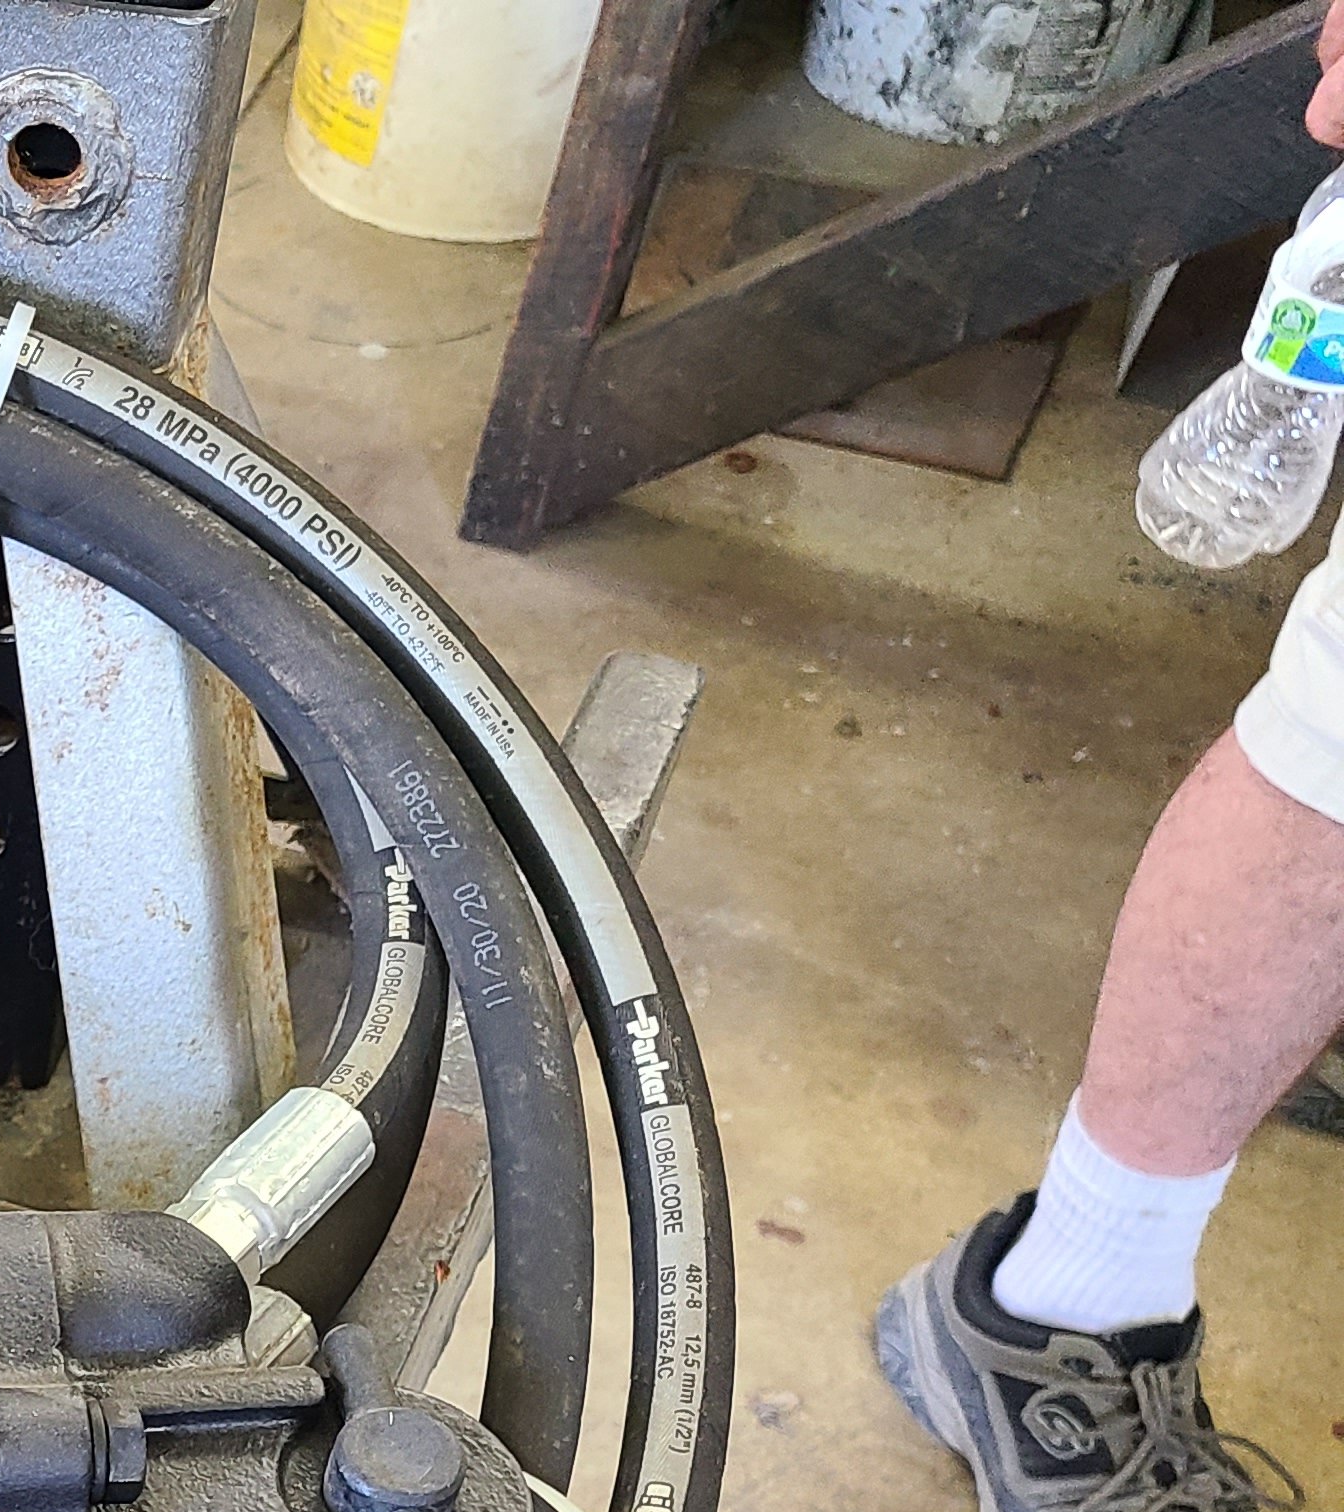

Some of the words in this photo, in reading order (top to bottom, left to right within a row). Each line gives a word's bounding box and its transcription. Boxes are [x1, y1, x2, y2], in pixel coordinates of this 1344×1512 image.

[113, 384, 157, 422] 28
[156, 408, 222, 464] MPa
[223, 451, 304, 521] (4000
[299, 512, 364, 573] PSI)
[391, 614, 411, 637] TO
[409, 600, 430, 623] TO
[462, 691, 490, 727] MADE
[486, 719, 500, 738] IN
[494, 732, 516, 760] USA
[384, 846, 418, 941] Parker
[452, 881, 513, 1011] 11/30/20
[361, 946, 407, 1045] GLOBALCORE
[329, 1063, 356, 1085] ISO
[625, 999, 670, 1106] Parker
[648, 1113, 684, 1237] GLOBALCORE
[659, 1265, 677, 1297] ISO
[684, 1263, 703, 1310] 487-8
[656, 1300, 677, 1380] 18752-AC
[680, 1333, 702, 1369] 12,5
[679, 1372, 697, 1405] mm
[668, 1407, 696, 1454] (1/2")
